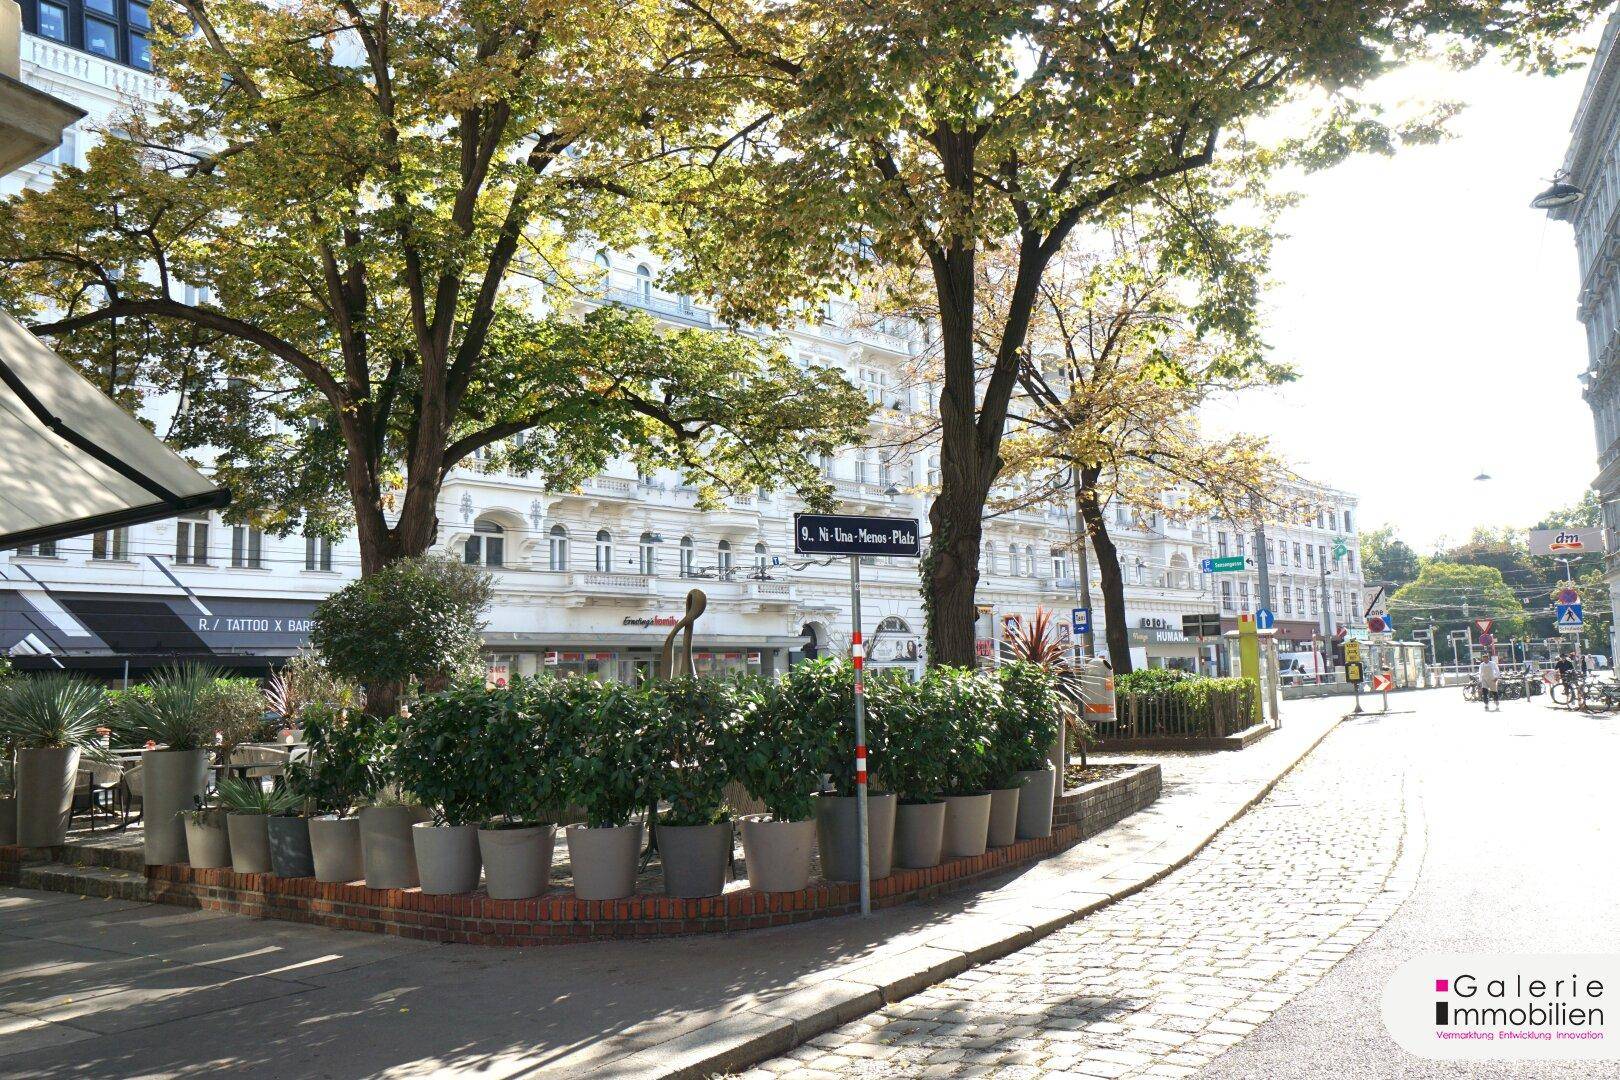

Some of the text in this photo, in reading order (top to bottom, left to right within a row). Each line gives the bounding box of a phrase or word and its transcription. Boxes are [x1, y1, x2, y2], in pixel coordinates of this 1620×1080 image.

[819, 526, 915, 545] Ni-Una-Menos-Platz
[1556, 532, 1579, 543] dm
[226, 618, 269, 632] TATTOO
[274, 619, 282, 632] X
